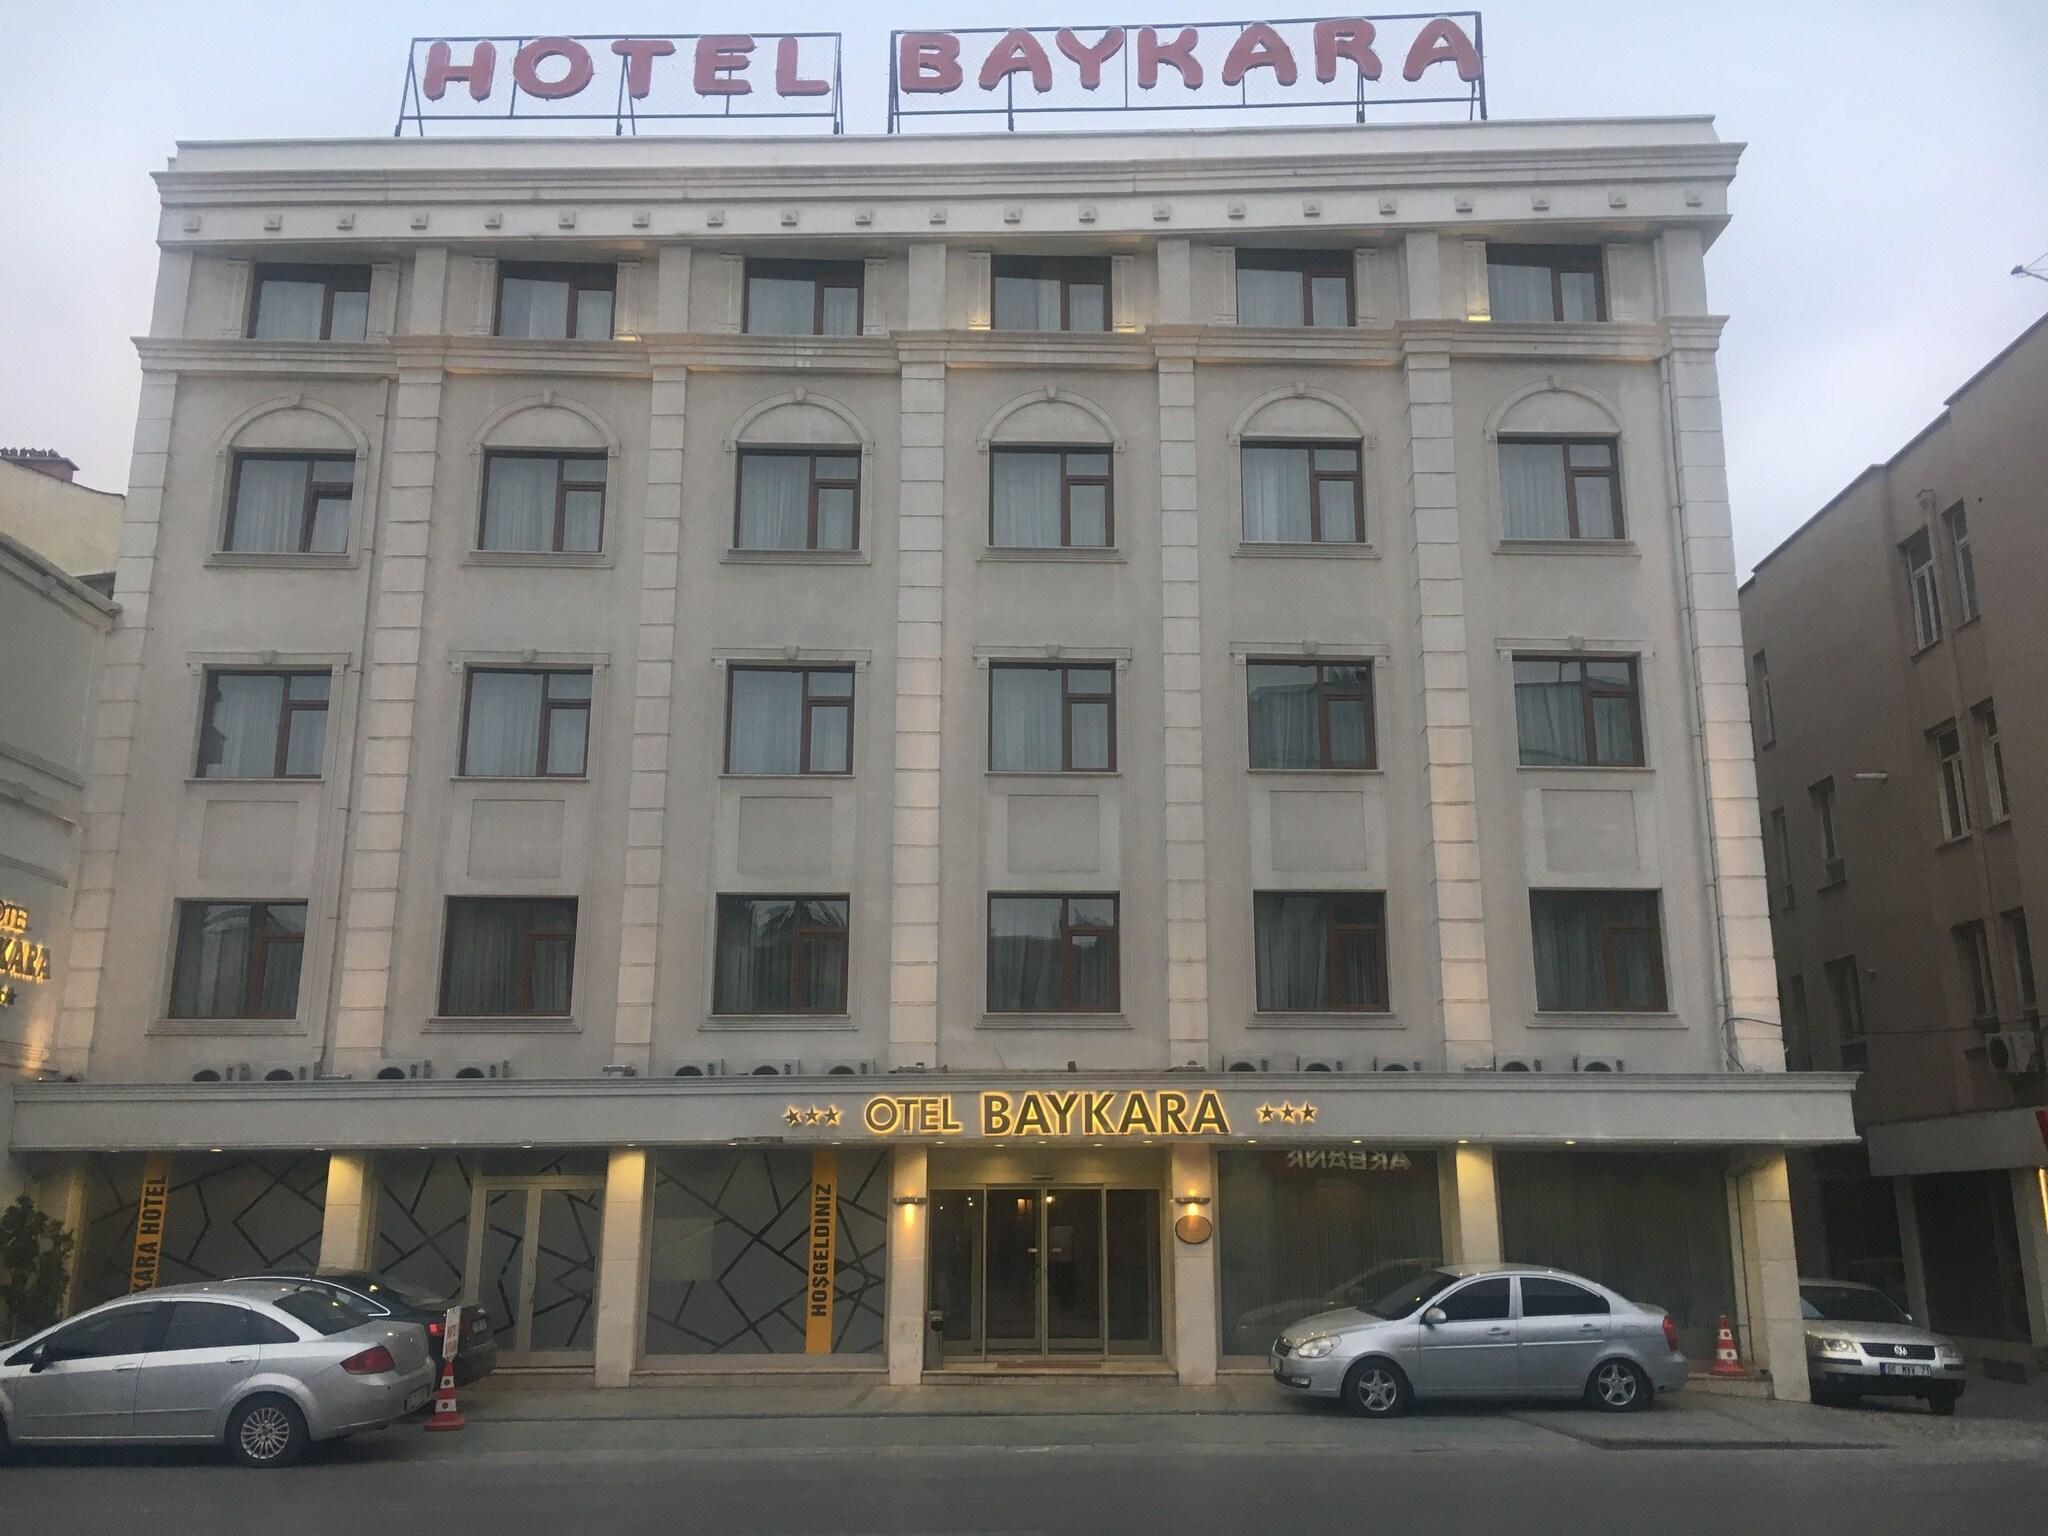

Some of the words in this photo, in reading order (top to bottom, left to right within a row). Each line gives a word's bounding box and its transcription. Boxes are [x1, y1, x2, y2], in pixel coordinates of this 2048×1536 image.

[423, 36, 830, 100] HOTEL
[900, 18, 1482, 93] BAYKARA
[865, 1095, 962, 1134] OTEL
[980, 1090, 1232, 1136] BAYKARA
[140, 1175, 167, 1235] HOTEL
